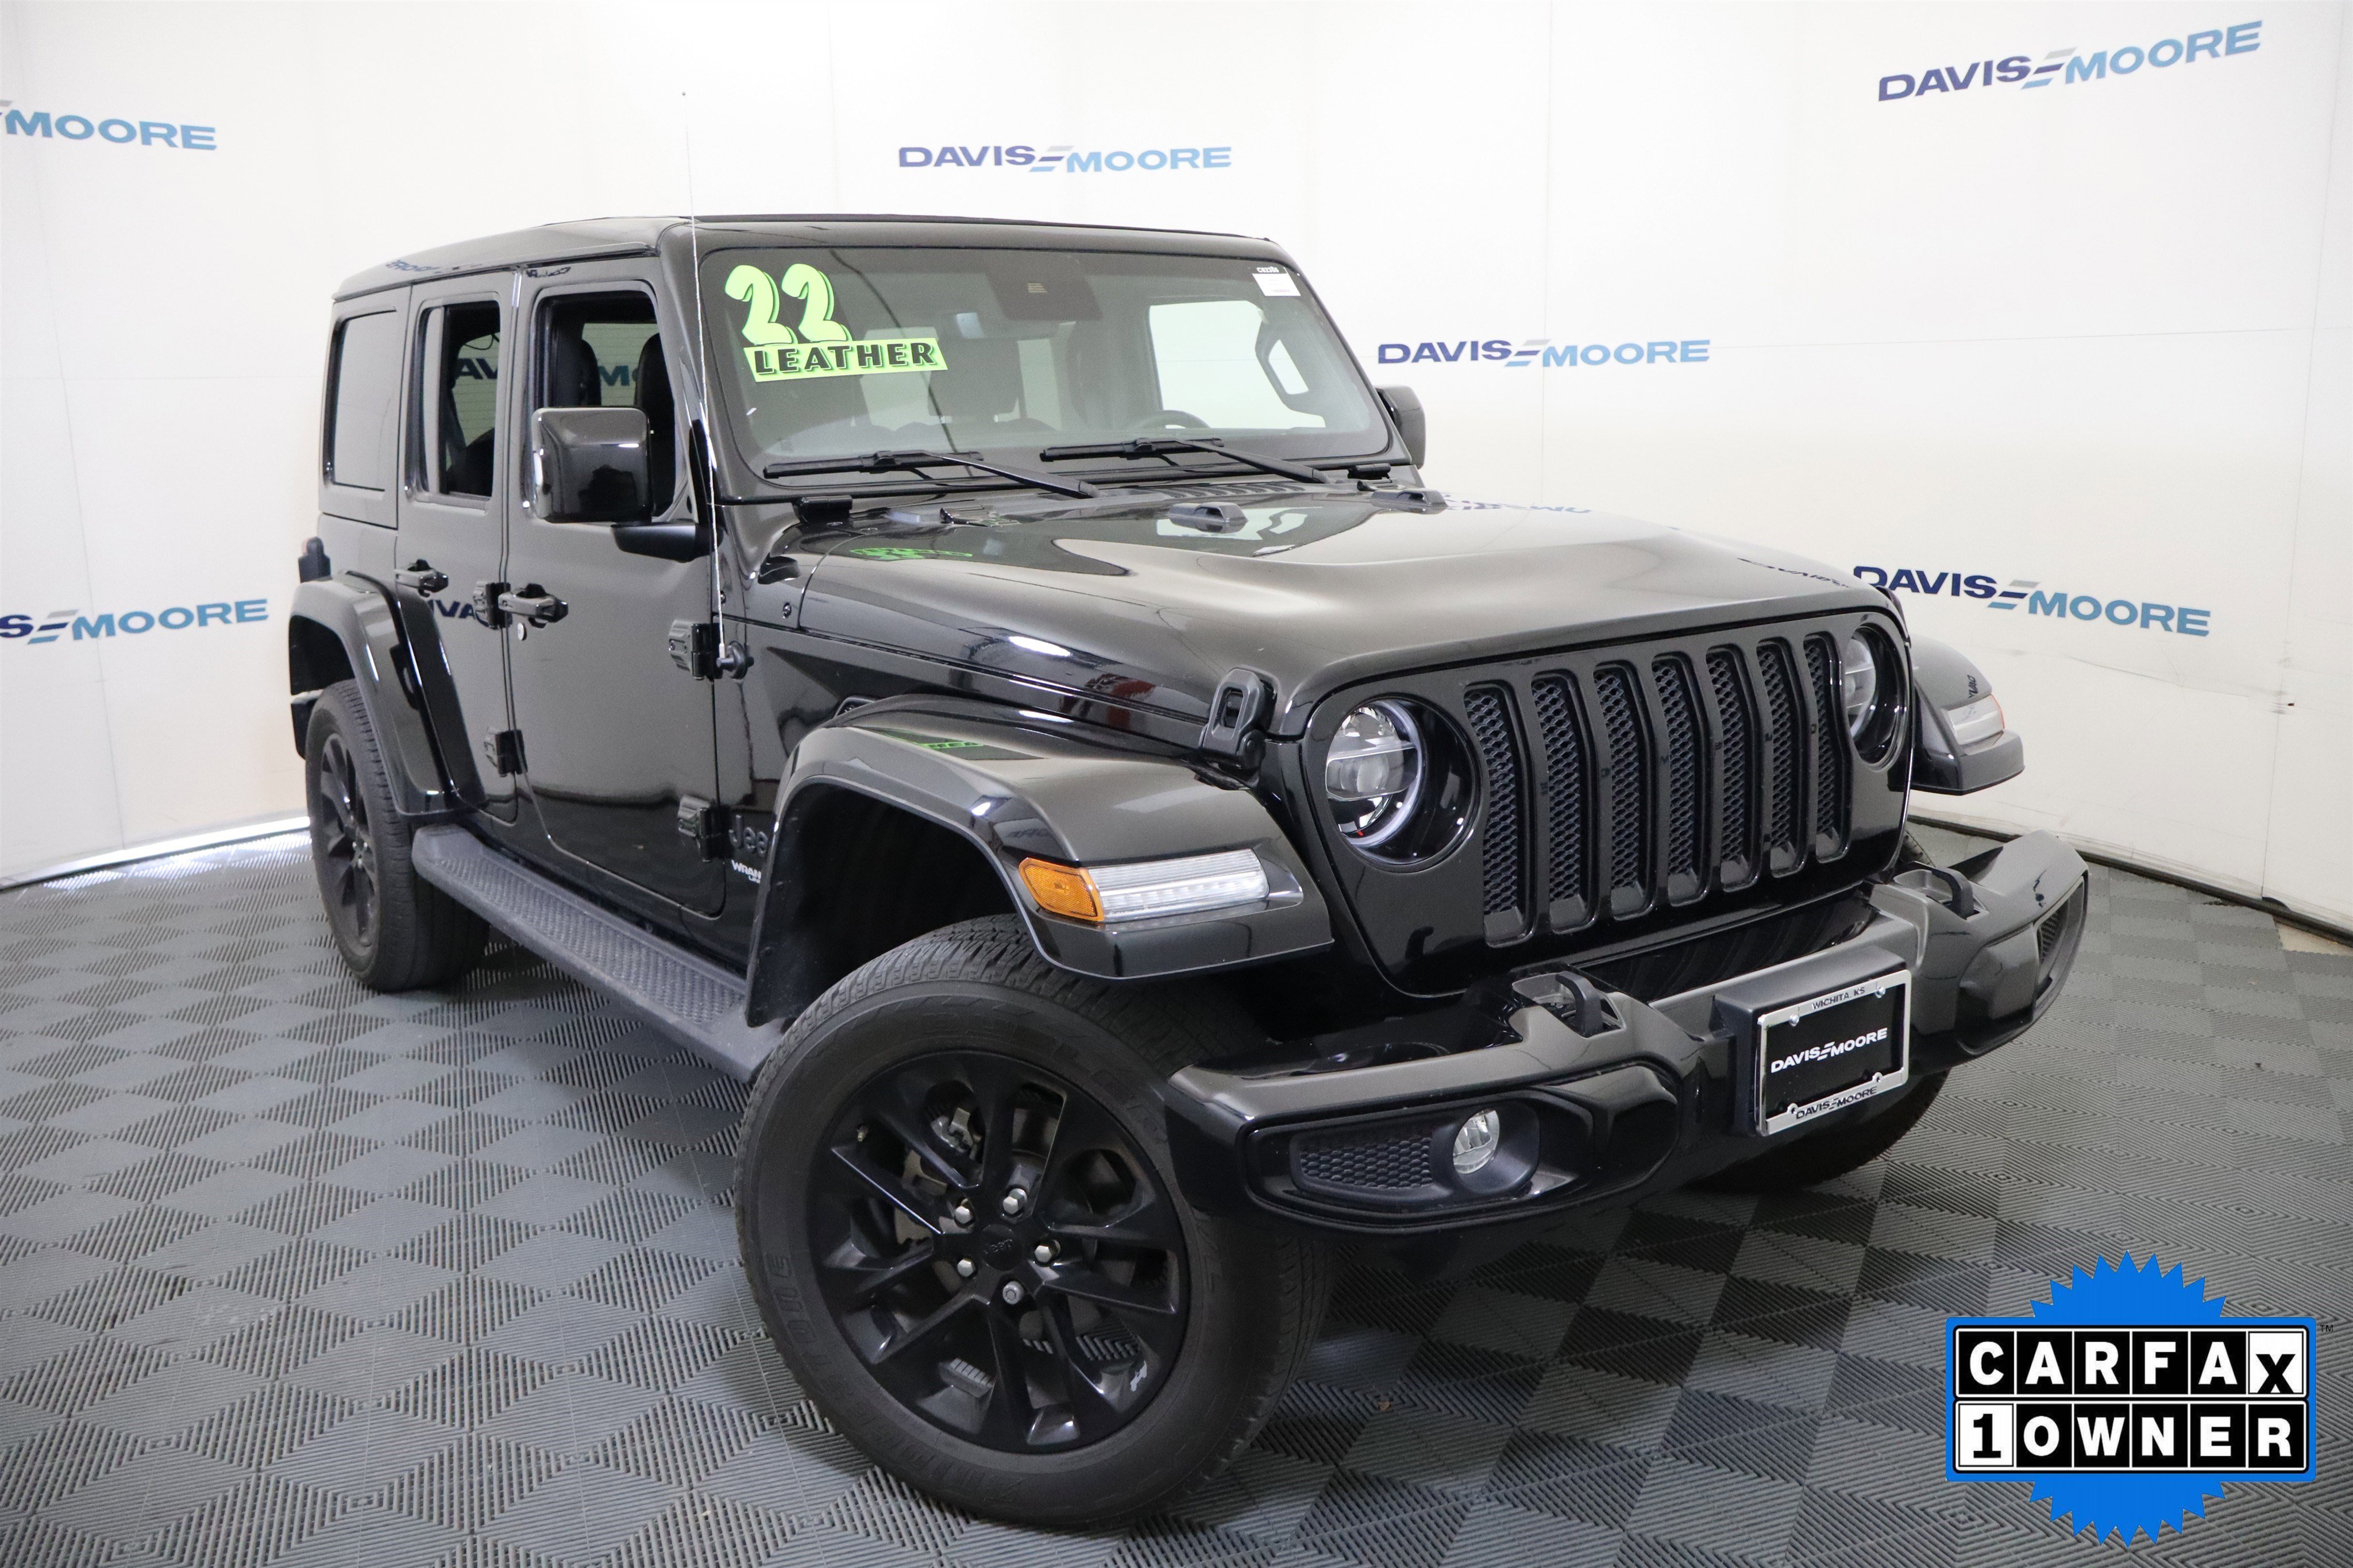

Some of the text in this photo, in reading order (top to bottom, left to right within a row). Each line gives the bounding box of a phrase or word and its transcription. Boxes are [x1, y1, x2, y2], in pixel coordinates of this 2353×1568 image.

[1878, 20, 2263, 101] DAVIS MOORE
[5, 109, 217, 150] MOORE
[899, 145, 1232, 173] DAVIS MOORE
[724, 262, 853, 345] 22
[754, 342, 936, 374] LEATHER
[1378, 339, 1711, 368] DAVIS MOORE
[72, 598, 269, 640] MOORE
[2028, 590, 2211, 636] MOORE
[728, 814, 768, 857] Jee
[1854, 987, 1865, 996] KS
[1771, 1028, 1888, 1073] DAVIS MOORE
[1796, 1086, 1877, 1119] DAVIS MOORE
